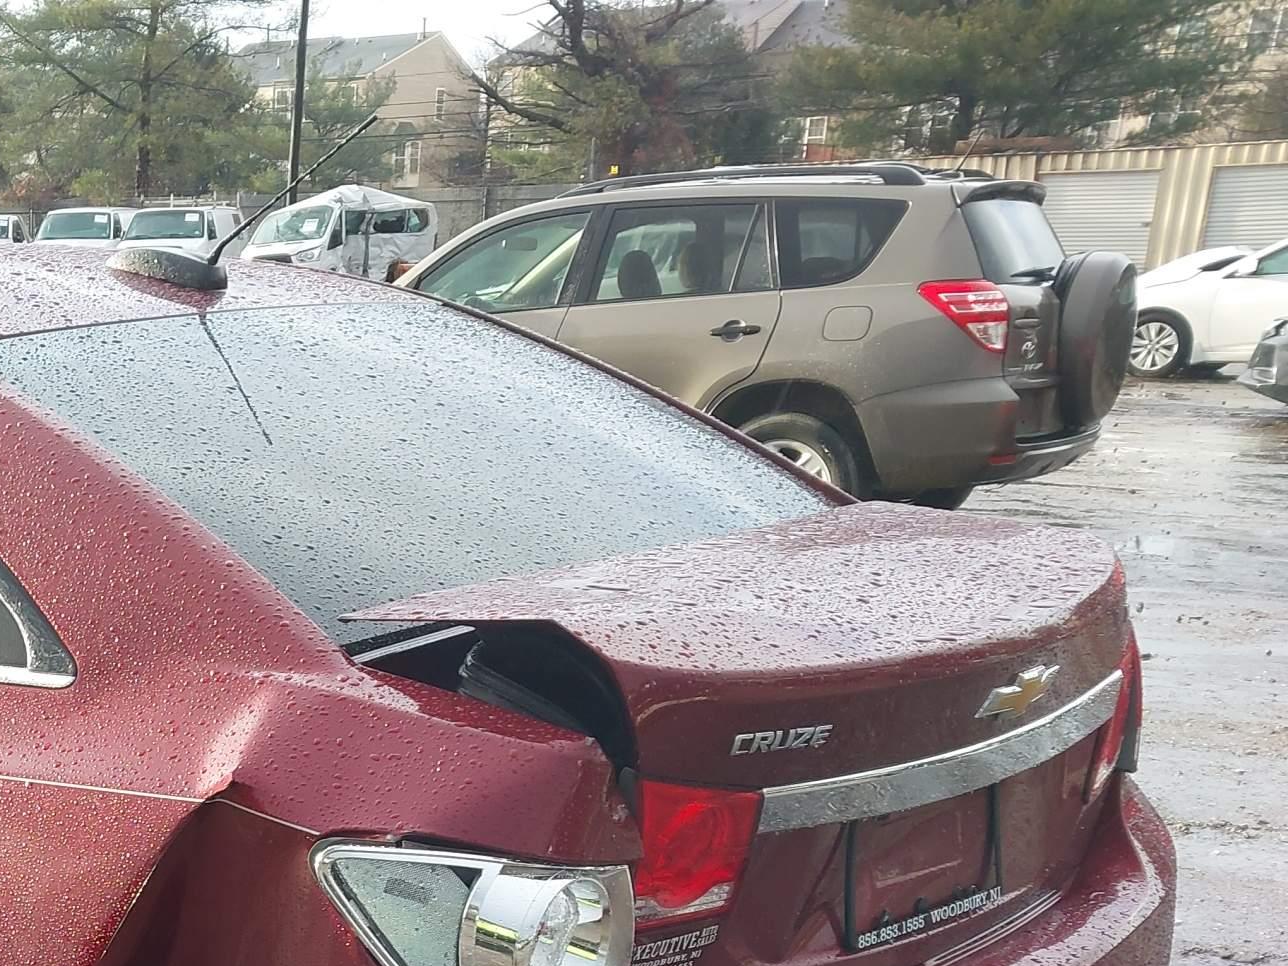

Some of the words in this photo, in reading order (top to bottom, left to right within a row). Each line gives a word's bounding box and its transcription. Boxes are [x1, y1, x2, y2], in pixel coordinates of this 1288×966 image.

[730, 724, 833, 756] CRUZE
[696, 935, 717, 947] SALES
[700, 925, 719, 937] AUTO
[857, 916, 925, 949] 856.853.1555
